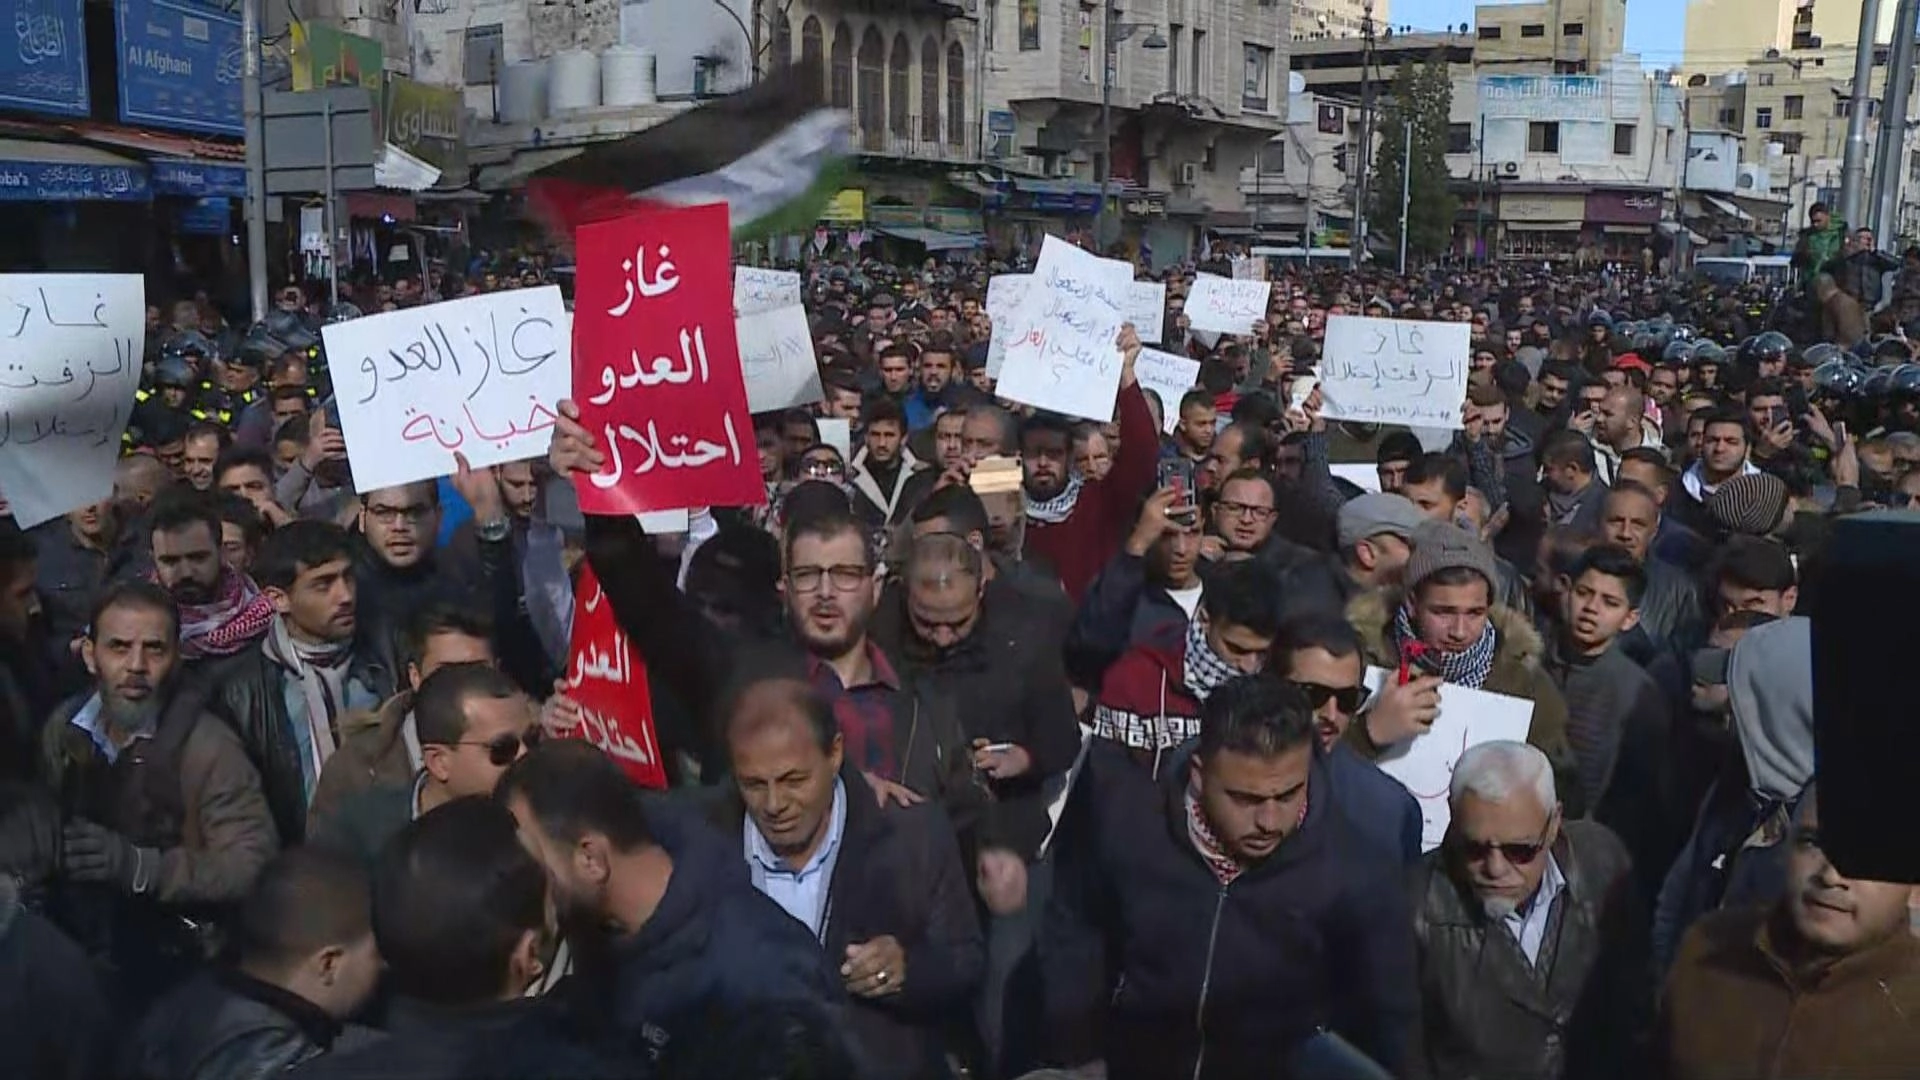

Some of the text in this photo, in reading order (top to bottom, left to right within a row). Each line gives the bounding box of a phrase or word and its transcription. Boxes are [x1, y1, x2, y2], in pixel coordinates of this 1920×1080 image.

[129, 45, 142, 66] Al
[145, 49, 192, 75] Afghani
[608, 244, 681, 317] غاز
[0, 338, 131, 401] الزفت
[358, 306, 556, 404] غاز العدو
[589, 325, 710, 405] العدو
[1382, 359, 1462, 397] الزفت
[402, 394, 558, 449] خيانة
[590, 410, 741, 489] احتلال
[568, 628, 631, 688] العدو
